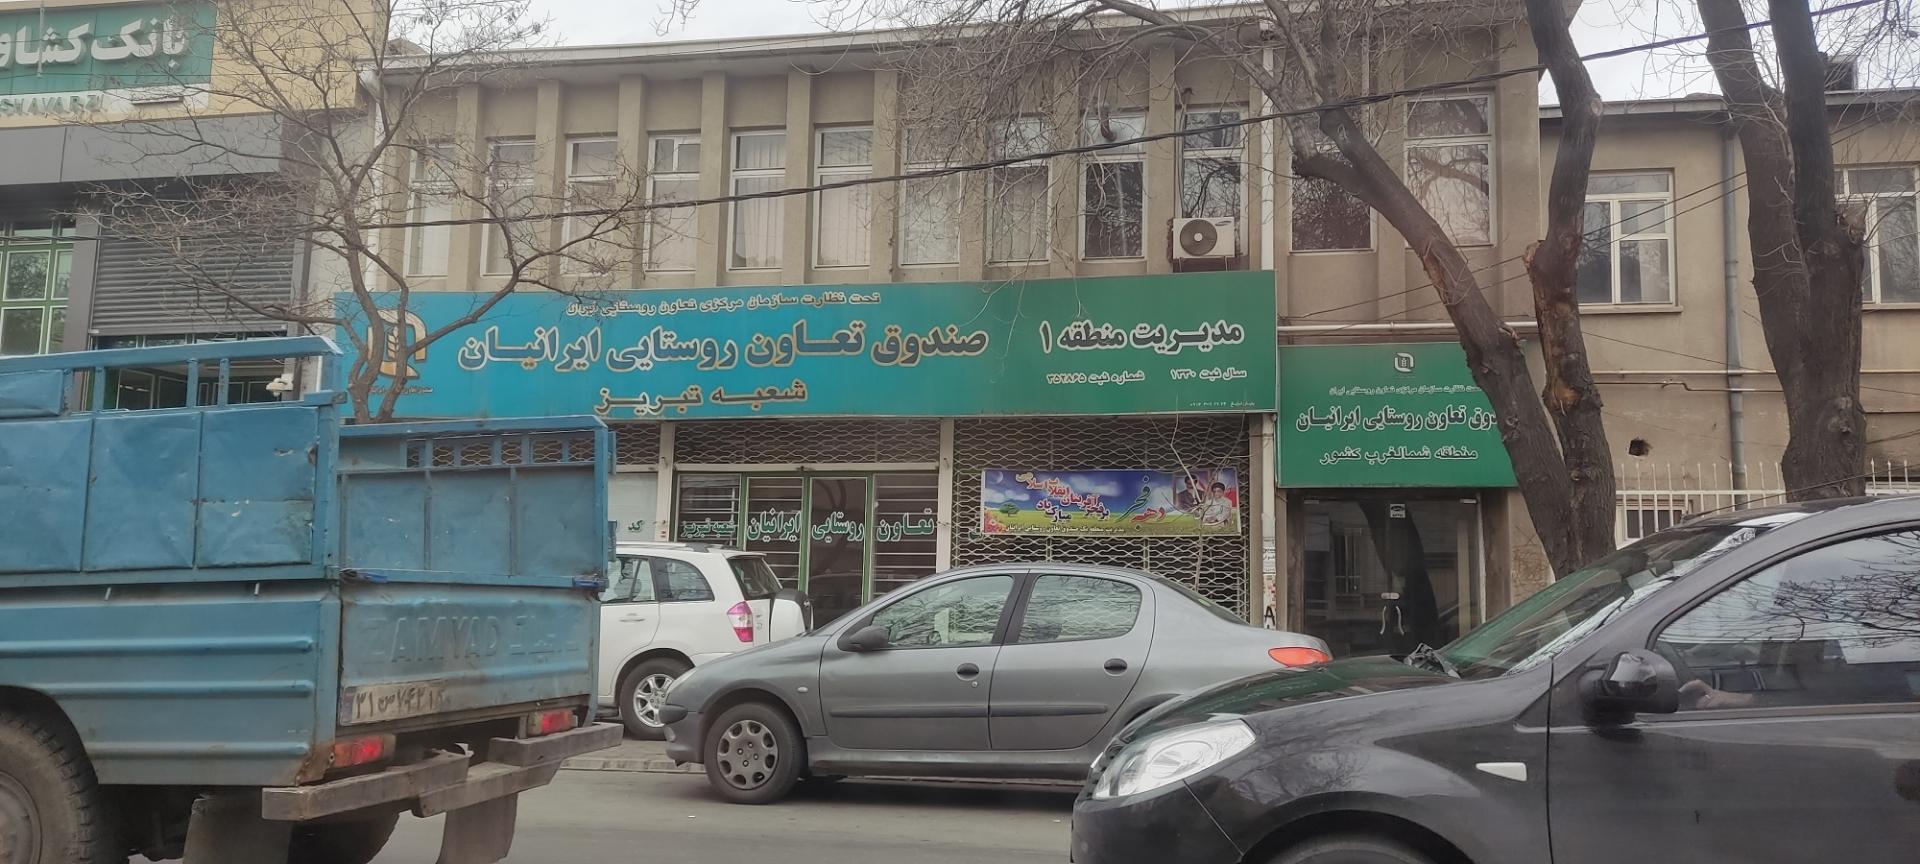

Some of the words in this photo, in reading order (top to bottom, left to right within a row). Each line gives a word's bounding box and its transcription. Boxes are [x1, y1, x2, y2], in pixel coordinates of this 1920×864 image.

[90, 16, 187, 69] بانک
[601, 299, 656, 316] روستایی
[658, 298, 697, 314] تعاون
[699, 297, 743, 312] مرکزی
[748, 293, 799, 309] سازمان
[801, 292, 846, 307] نظارت
[849, 292, 881, 305] تحت
[745, 319, 866, 367] تعاون
[871, 324, 989, 366] صندوق
[1057, 320, 1127, 350] منطقه
[1130, 320, 1245, 355] مدیریت
[457, 325, 601, 372] ایرانیان
[606, 325, 738, 372] روستایی
[1088, 371, 1110, 385] ثبت
[1111, 370, 1145, 385] شماره
[1199, 367, 1222, 381] ثبت
[1223, 367, 1247, 380] سال
[593, 384, 702, 415] تبریز
[710, 378, 808, 411] شعبه
[1296, 405, 1361, 432] ایرانیان
[1363, 405, 1423, 431] روستایی
[1425, 404, 1466, 430] تعاون
[1320, 447, 1362, 465] کشور
[1435, 445, 1477, 460] منطقه
[681, 517, 711, 538] تبریز
[711, 519, 736, 538] شعبه
[746, 507, 801, 543] ایرانیان
[811, 511, 865, 543] روستایی
[876, 508, 934, 541] تعاون
